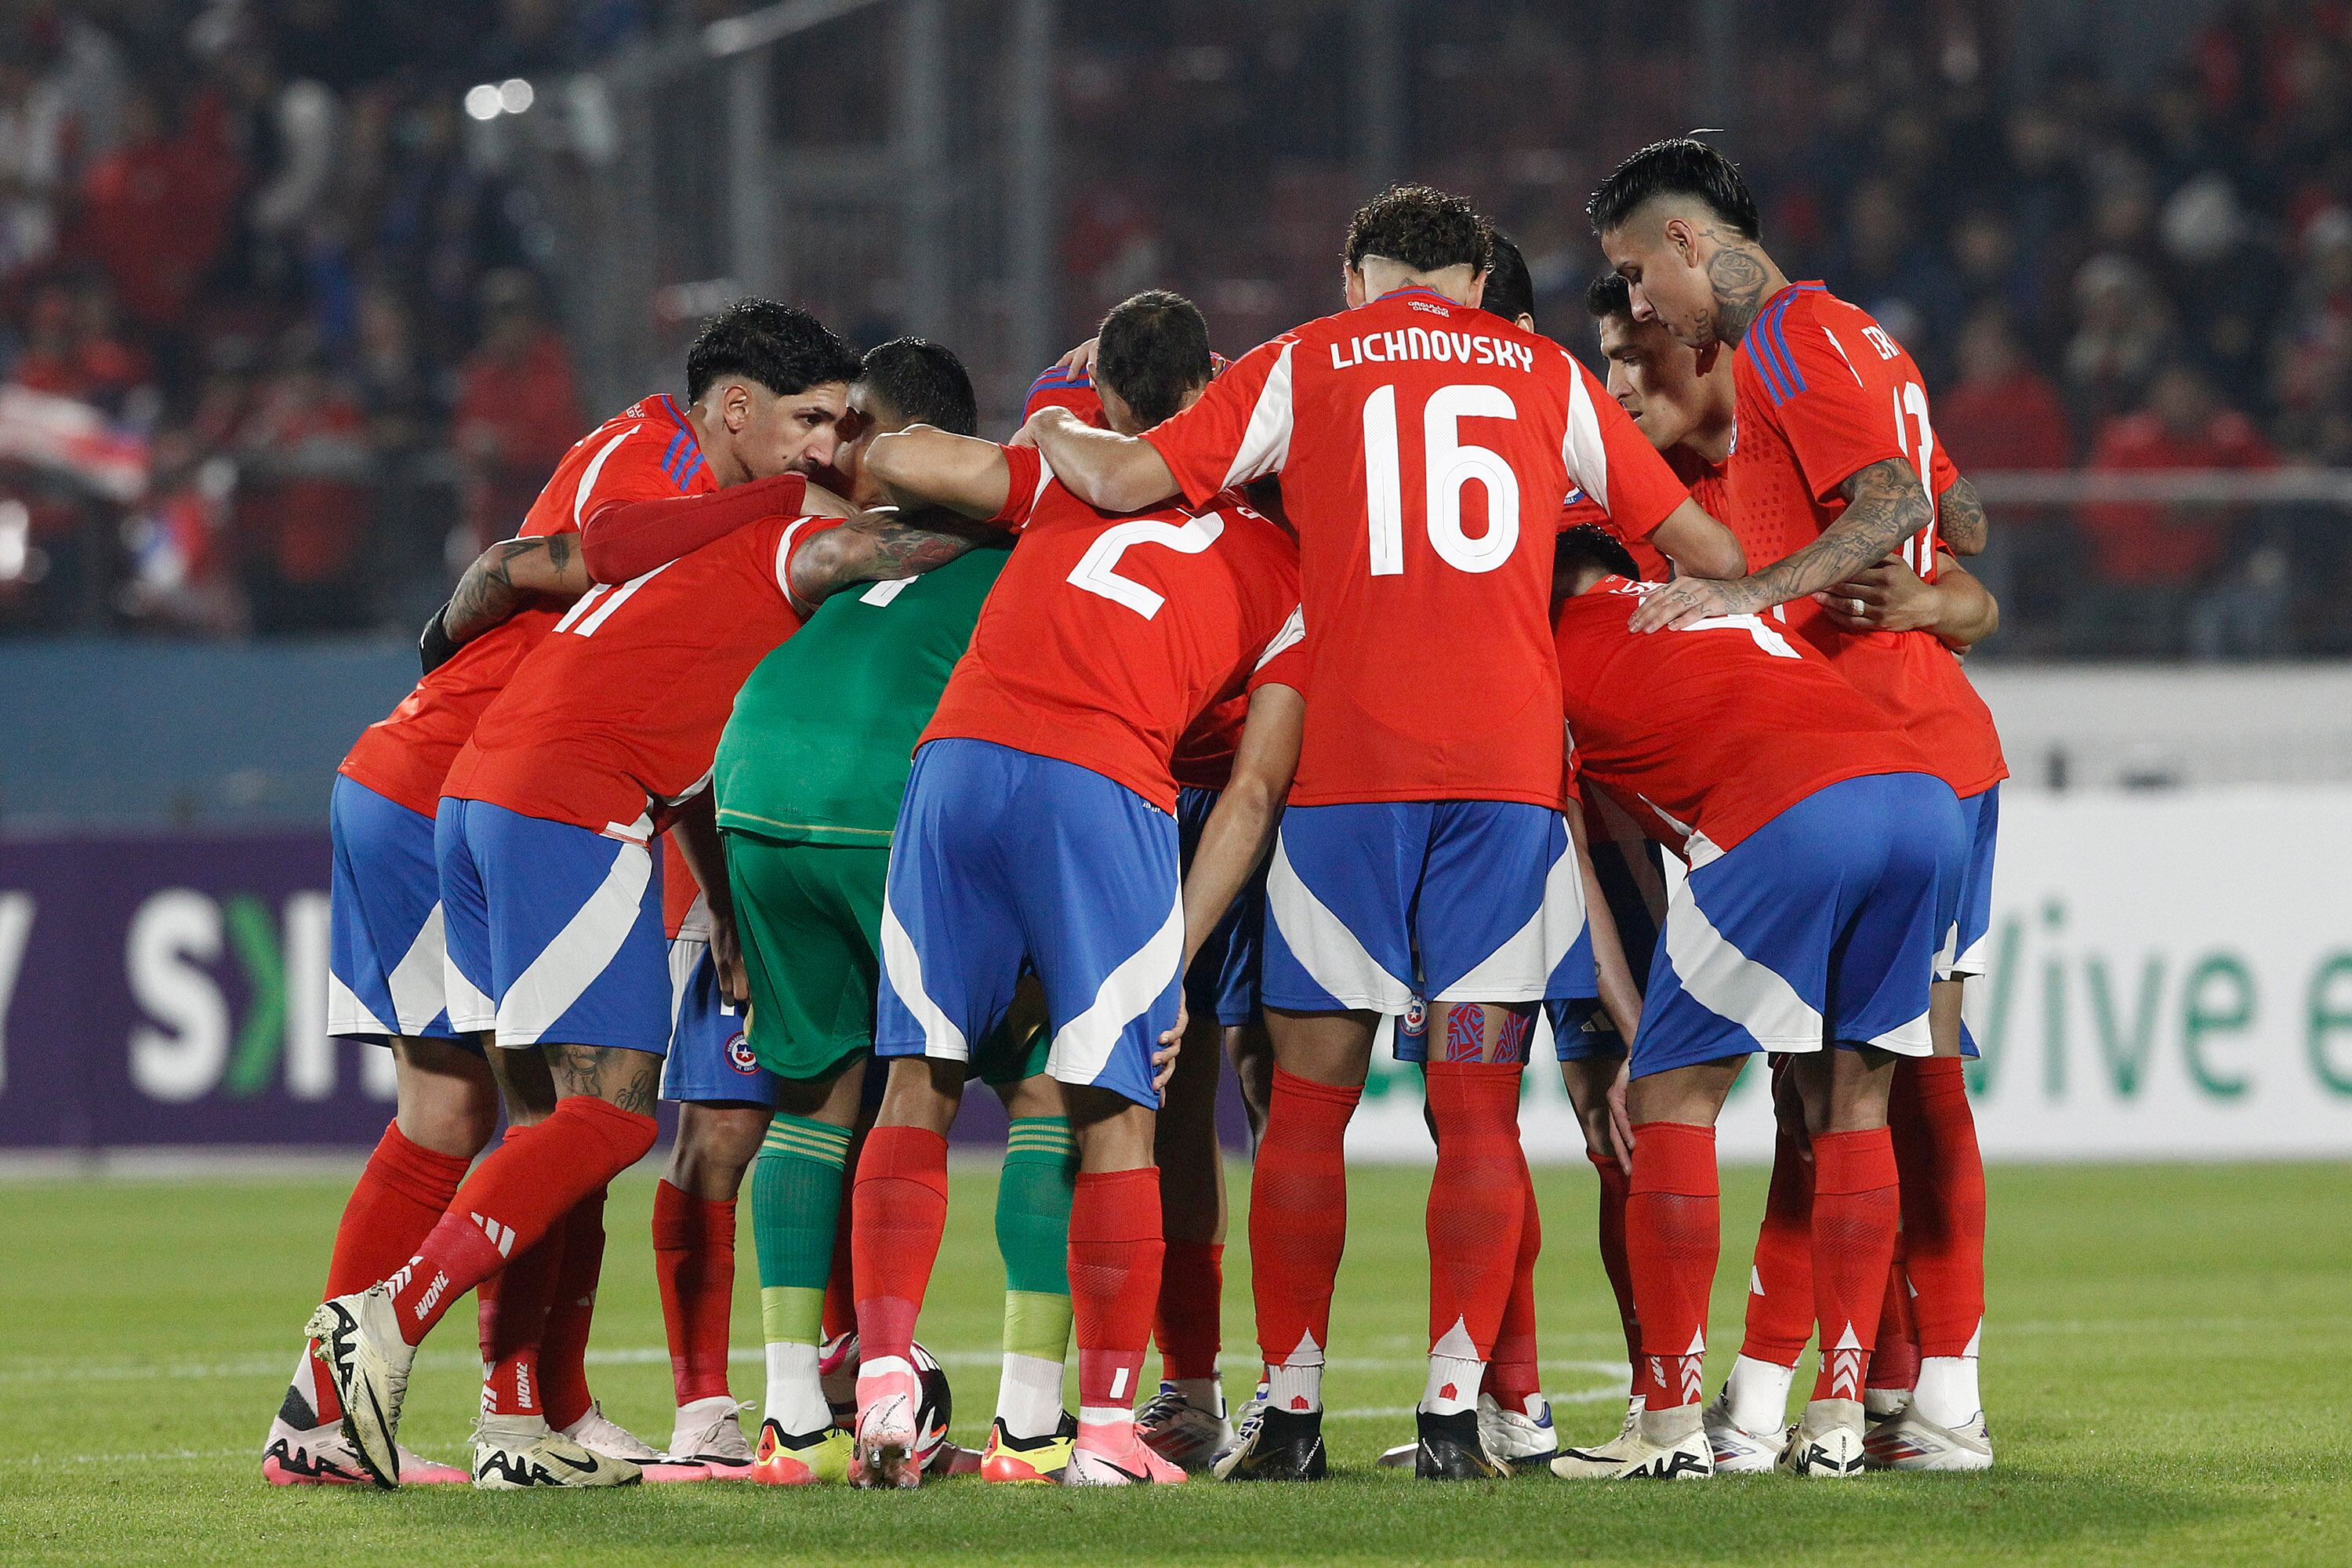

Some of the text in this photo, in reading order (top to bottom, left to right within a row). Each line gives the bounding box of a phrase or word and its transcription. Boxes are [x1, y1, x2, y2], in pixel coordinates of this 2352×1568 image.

[1330, 327, 1534, 373] LICHNOVSKY
[1363, 384, 1520, 576] 16
[1065, 508, 1225, 622] 2
[1510, 1417, 1528, 1428] COPA
